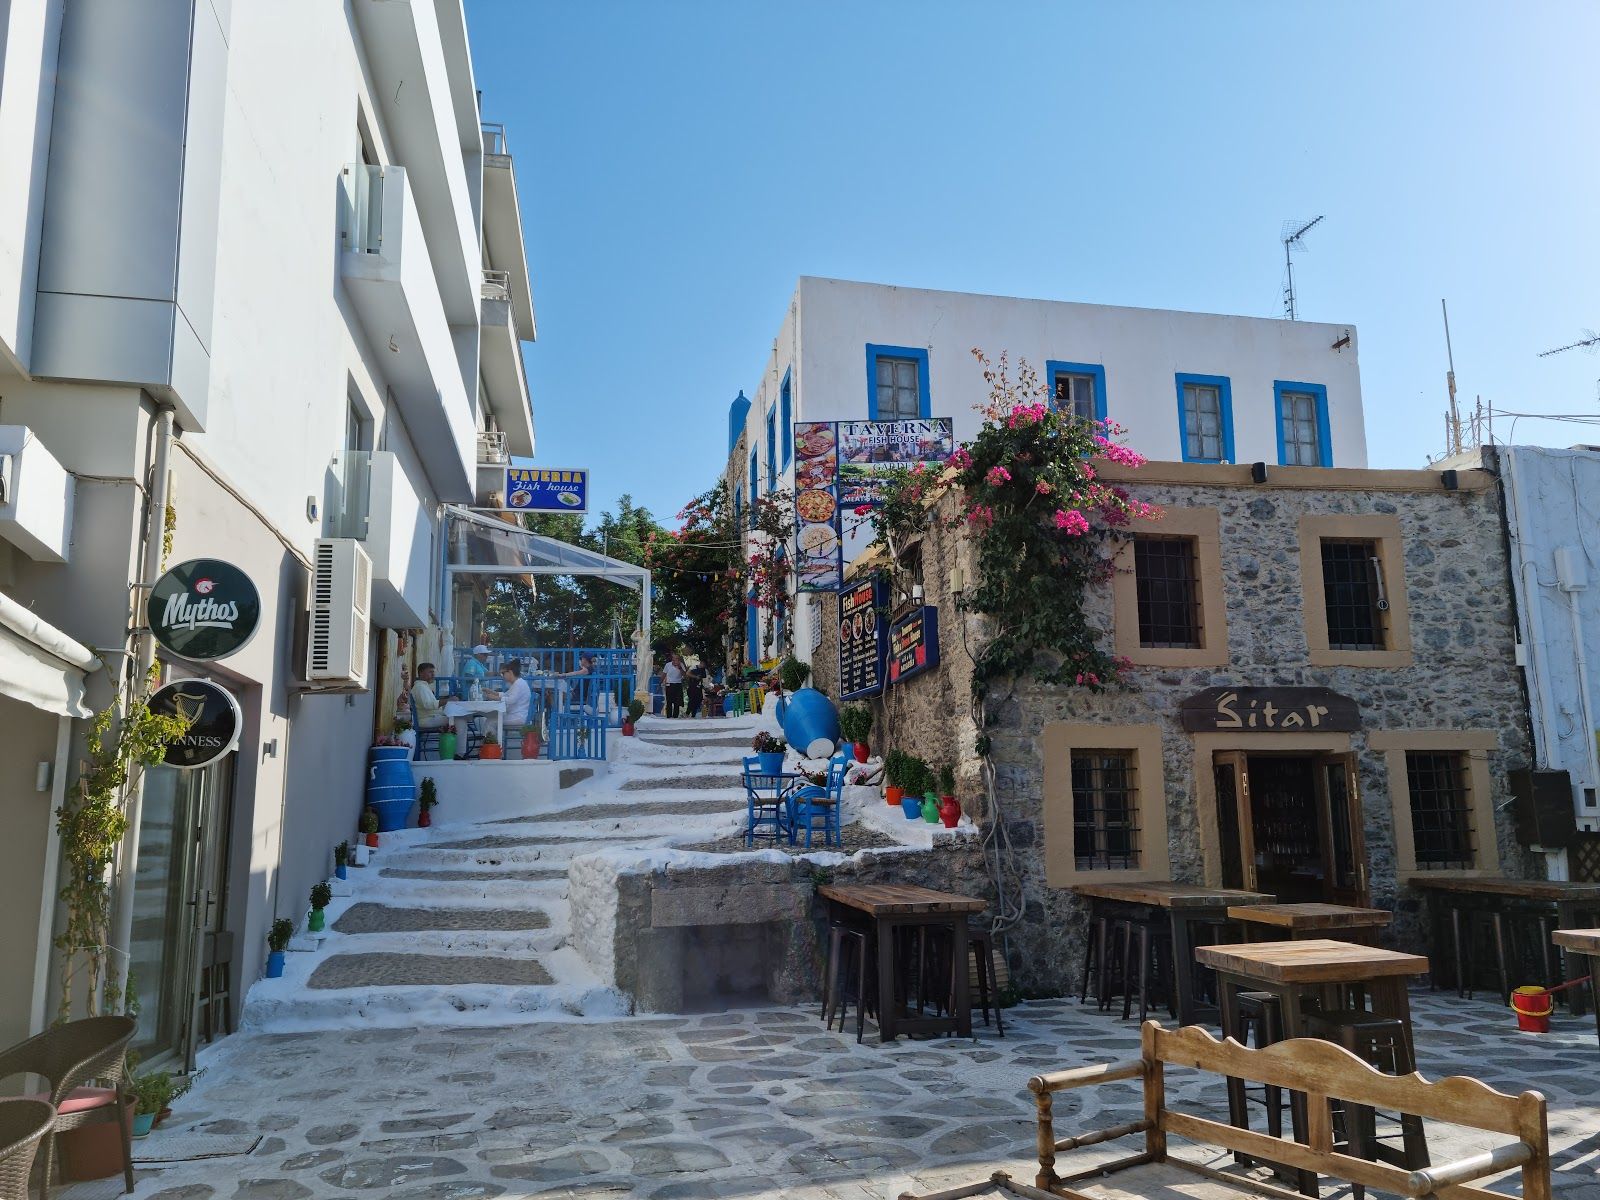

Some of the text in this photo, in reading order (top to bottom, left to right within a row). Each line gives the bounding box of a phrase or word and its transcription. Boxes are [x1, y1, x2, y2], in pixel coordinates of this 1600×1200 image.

[843, 420, 949, 436] TAVERNA
[868, 435, 920, 444] FISH HOUSE
[509, 469, 582, 483] TAVERNA
[512, 481, 579, 492] Fish house
[161, 592, 239, 631] Mythos
[1215, 691, 1329, 728] Sitar
